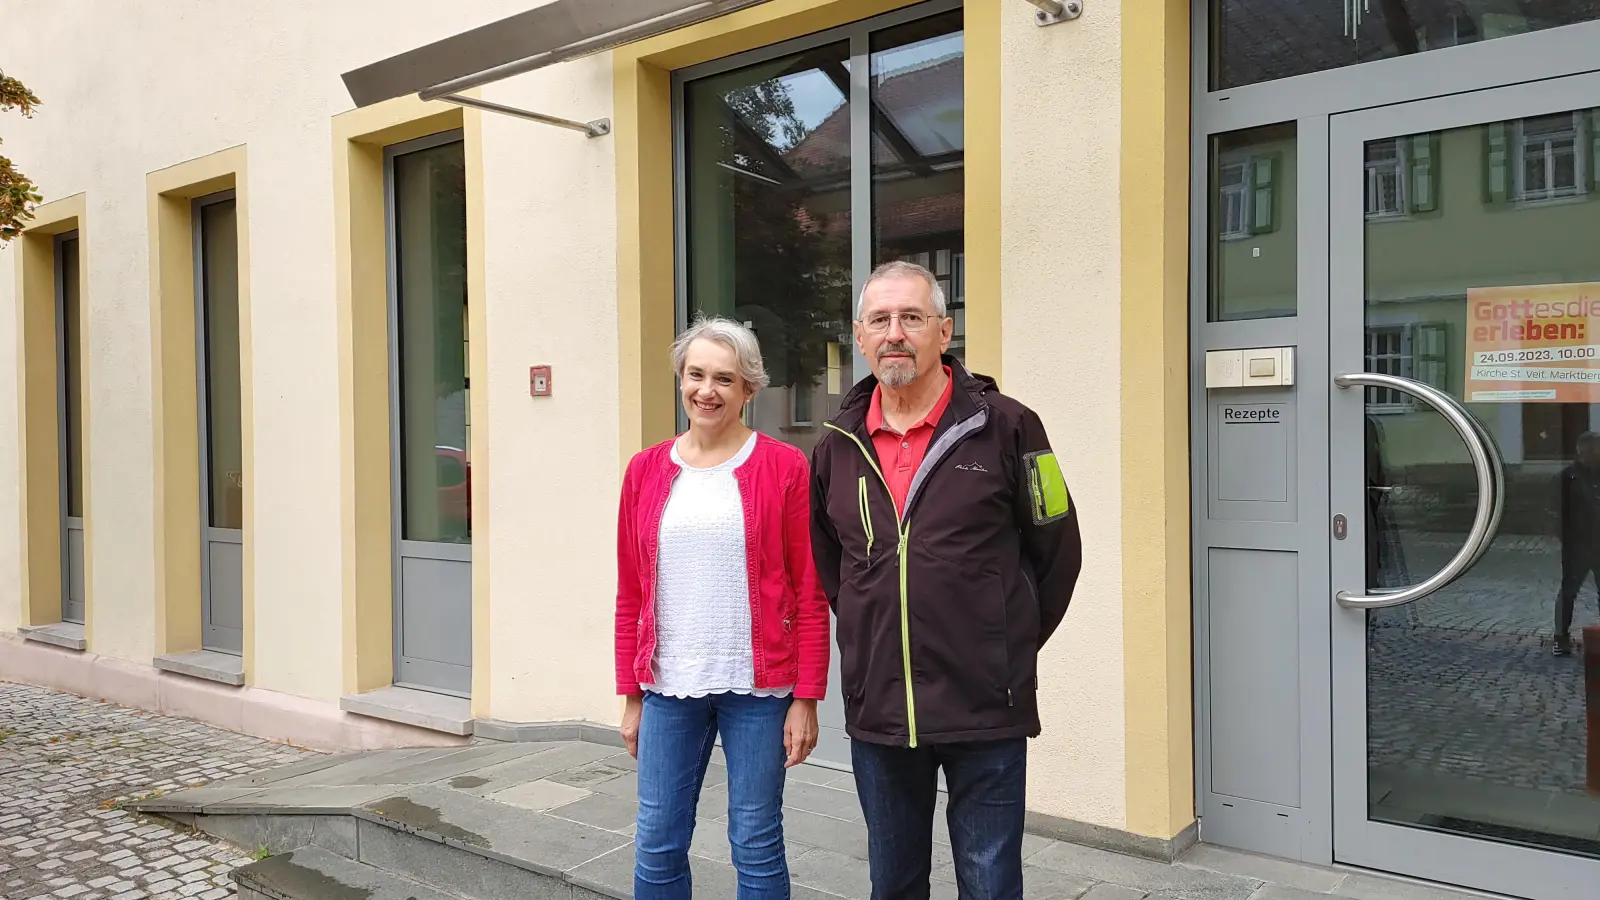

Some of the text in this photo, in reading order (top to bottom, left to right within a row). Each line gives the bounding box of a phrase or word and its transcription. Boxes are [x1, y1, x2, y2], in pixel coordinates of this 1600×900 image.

[1473, 296, 1600, 321] Gottesdie
[1473, 320, 1585, 342] erleben:
[1480, 347, 1595, 364] 24.09.2023, 10.00
[1476, 369, 1508, 378] Kirche
[1224, 408, 1280, 421] Rezepte
